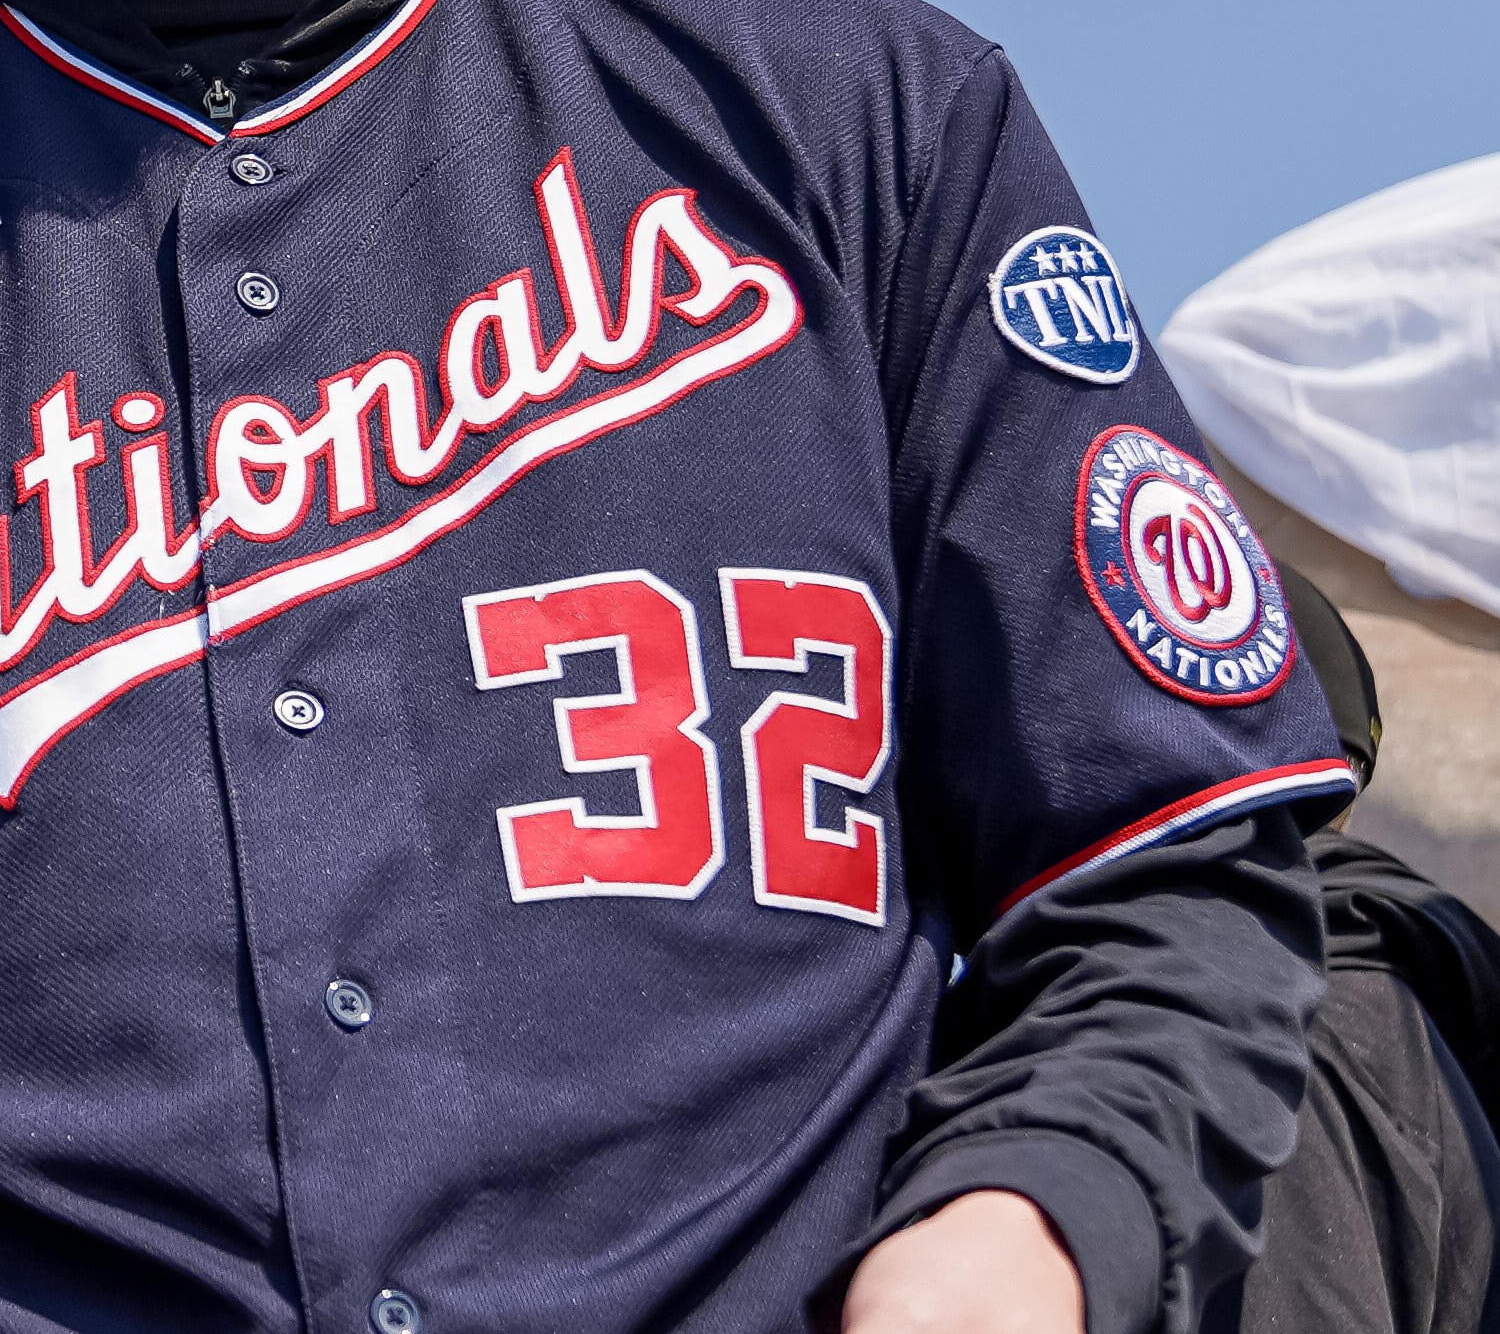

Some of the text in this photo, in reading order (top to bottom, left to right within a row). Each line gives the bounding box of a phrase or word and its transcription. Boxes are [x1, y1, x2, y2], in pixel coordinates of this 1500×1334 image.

[1004, 273, 1135, 348] TNL
[1089, 434, 1257, 539] WASHINGTON
[1124, 601, 1290, 690] NATIONALS
[463, 567, 893, 927] 32
